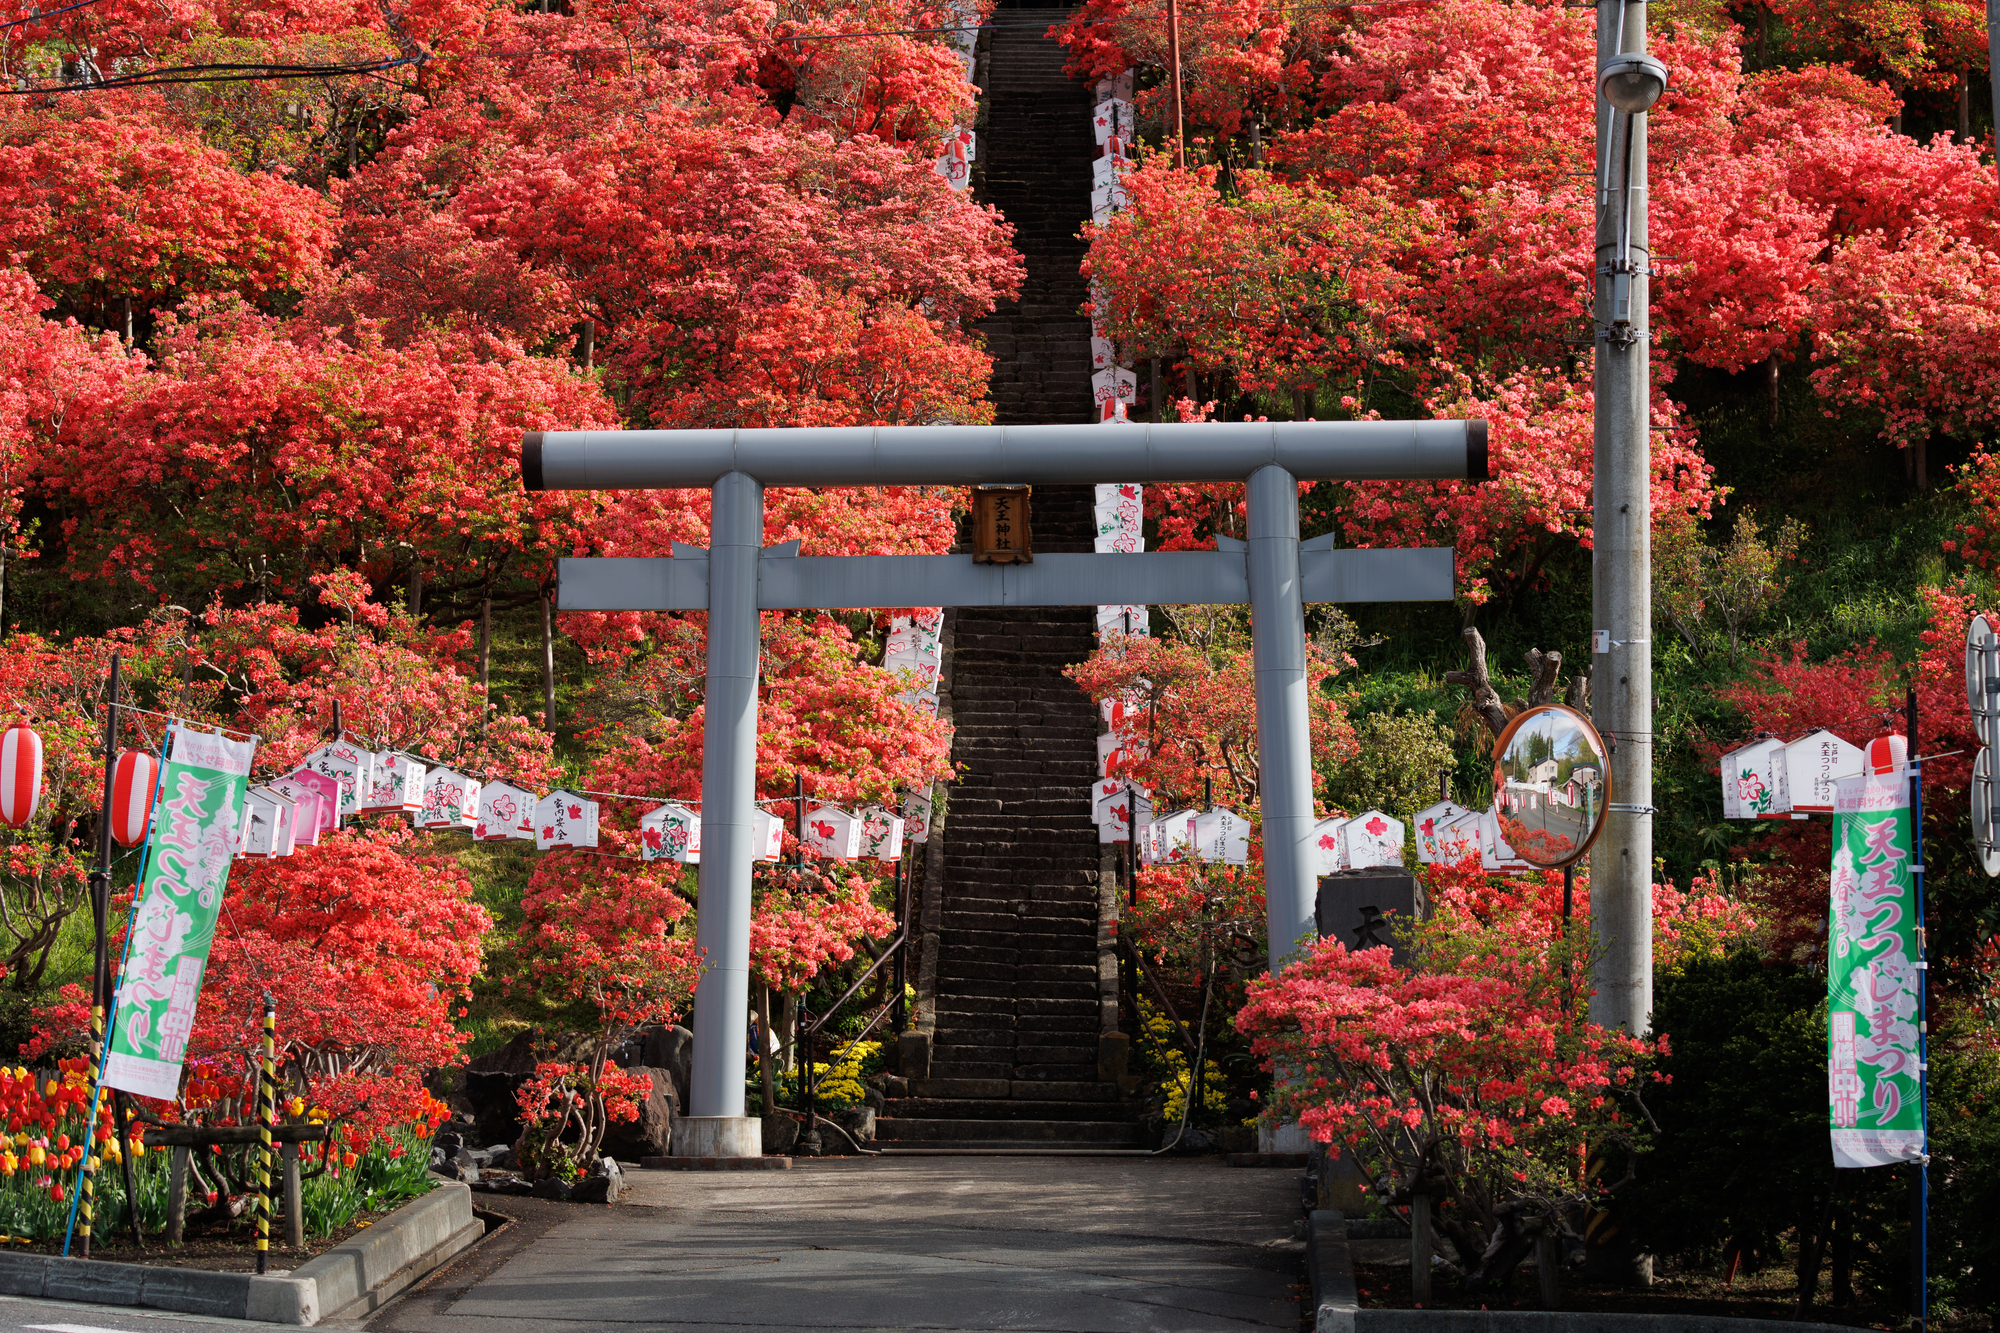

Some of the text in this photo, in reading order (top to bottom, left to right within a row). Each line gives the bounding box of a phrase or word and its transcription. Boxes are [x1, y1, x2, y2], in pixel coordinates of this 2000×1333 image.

[994, 496, 1012, 550] 天王神社
[553, 798, 568, 841] 家内安全
[1219, 815, 1227, 857] 天王つつじまつり
[1351, 905, 1393, 951] 天
[1858, 817, 1907, 1126] 天王つつじまつり
